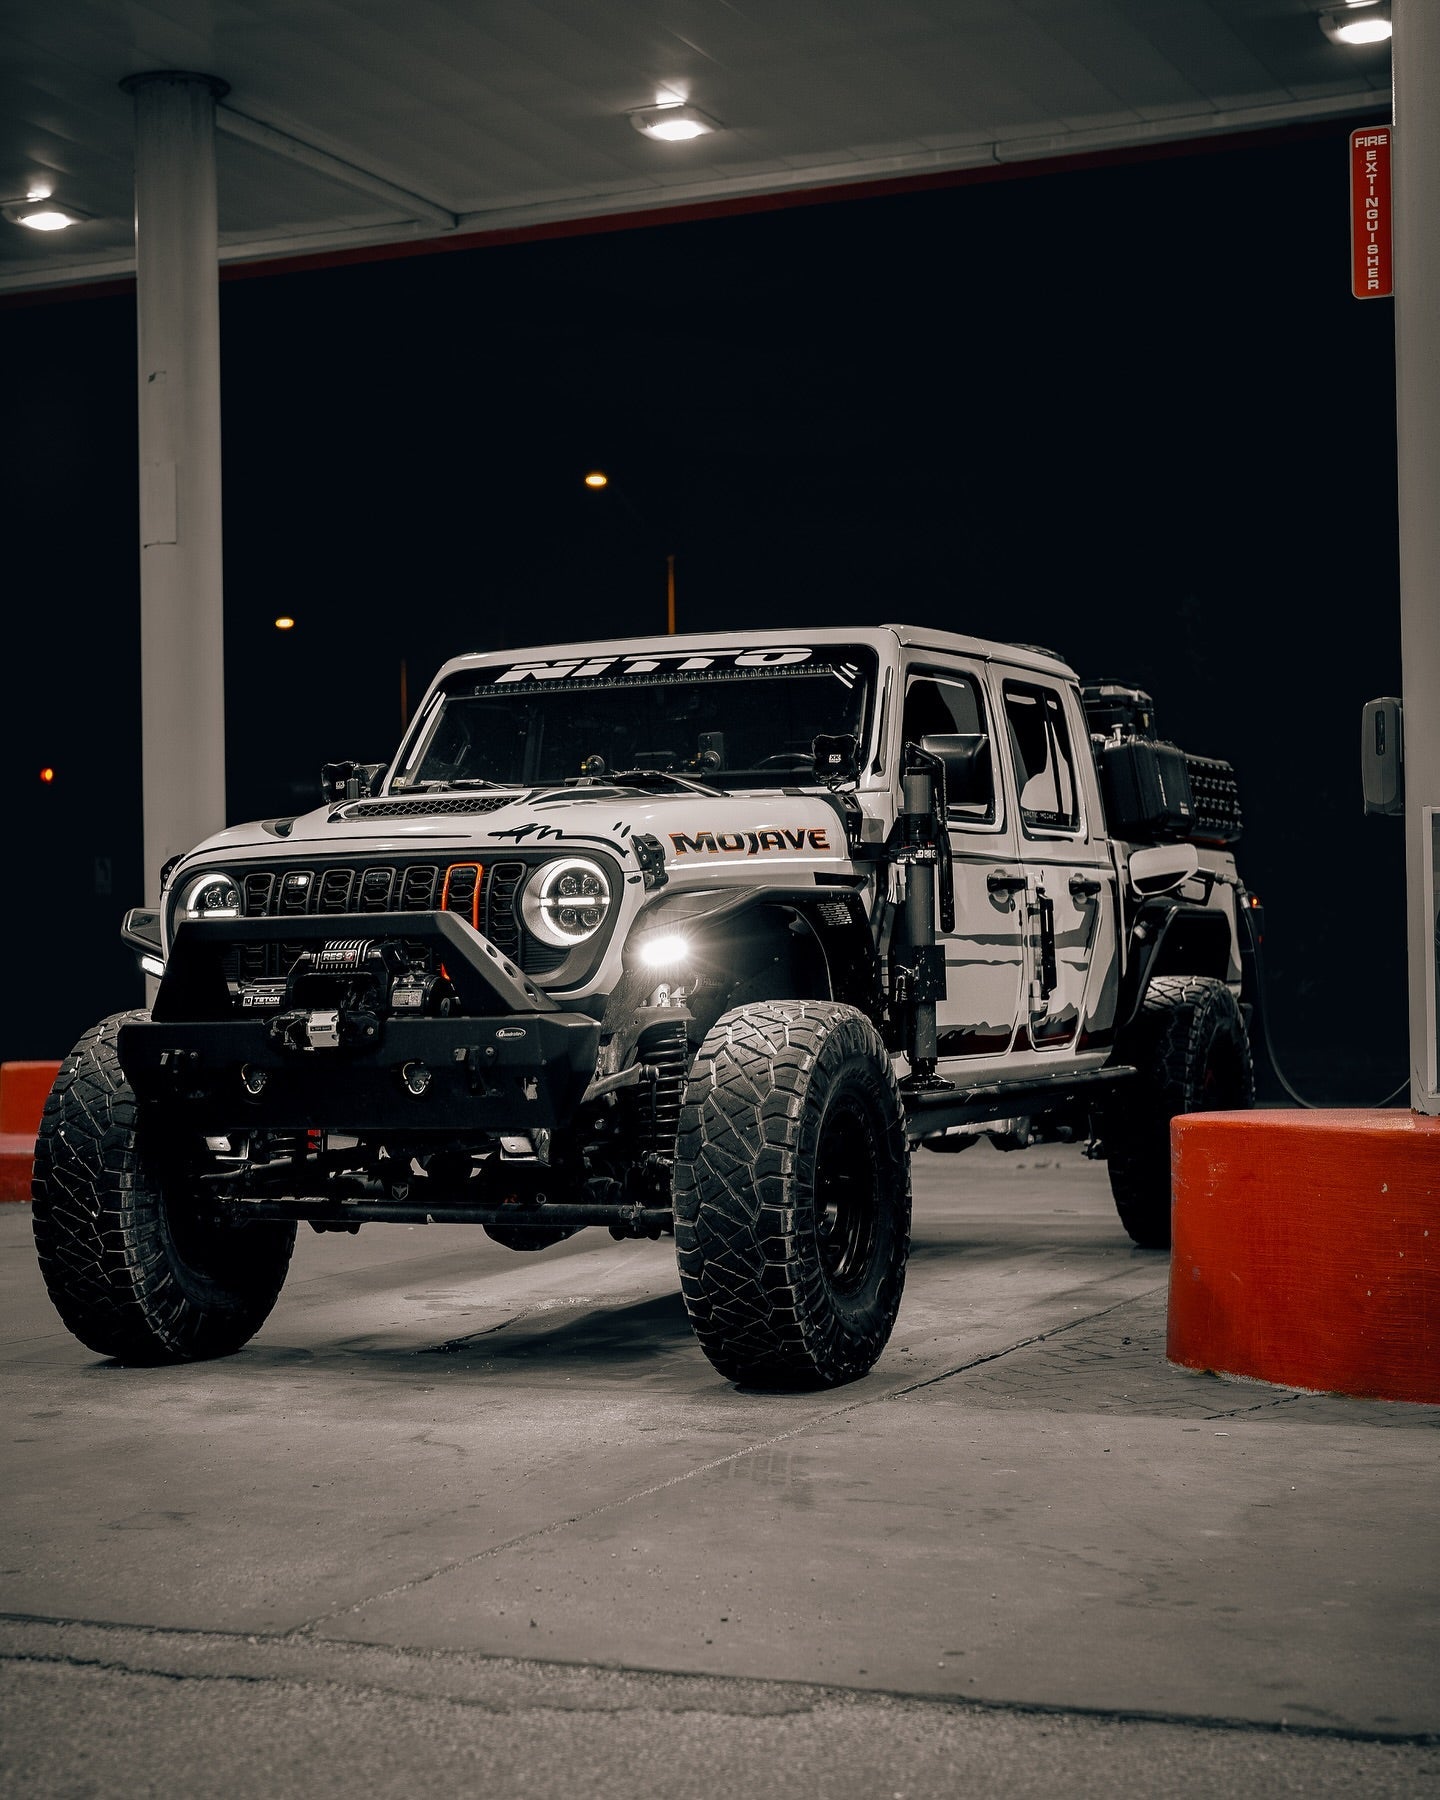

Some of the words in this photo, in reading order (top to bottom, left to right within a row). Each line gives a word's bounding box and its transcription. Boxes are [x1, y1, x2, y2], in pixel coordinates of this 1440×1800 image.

[1355, 134, 1388, 148] FIRE
[1365, 150, 1379, 290] EXTINGUISHER
[495, 647, 813, 683] NITTO
[668, 828, 831, 856] MOJAVE
